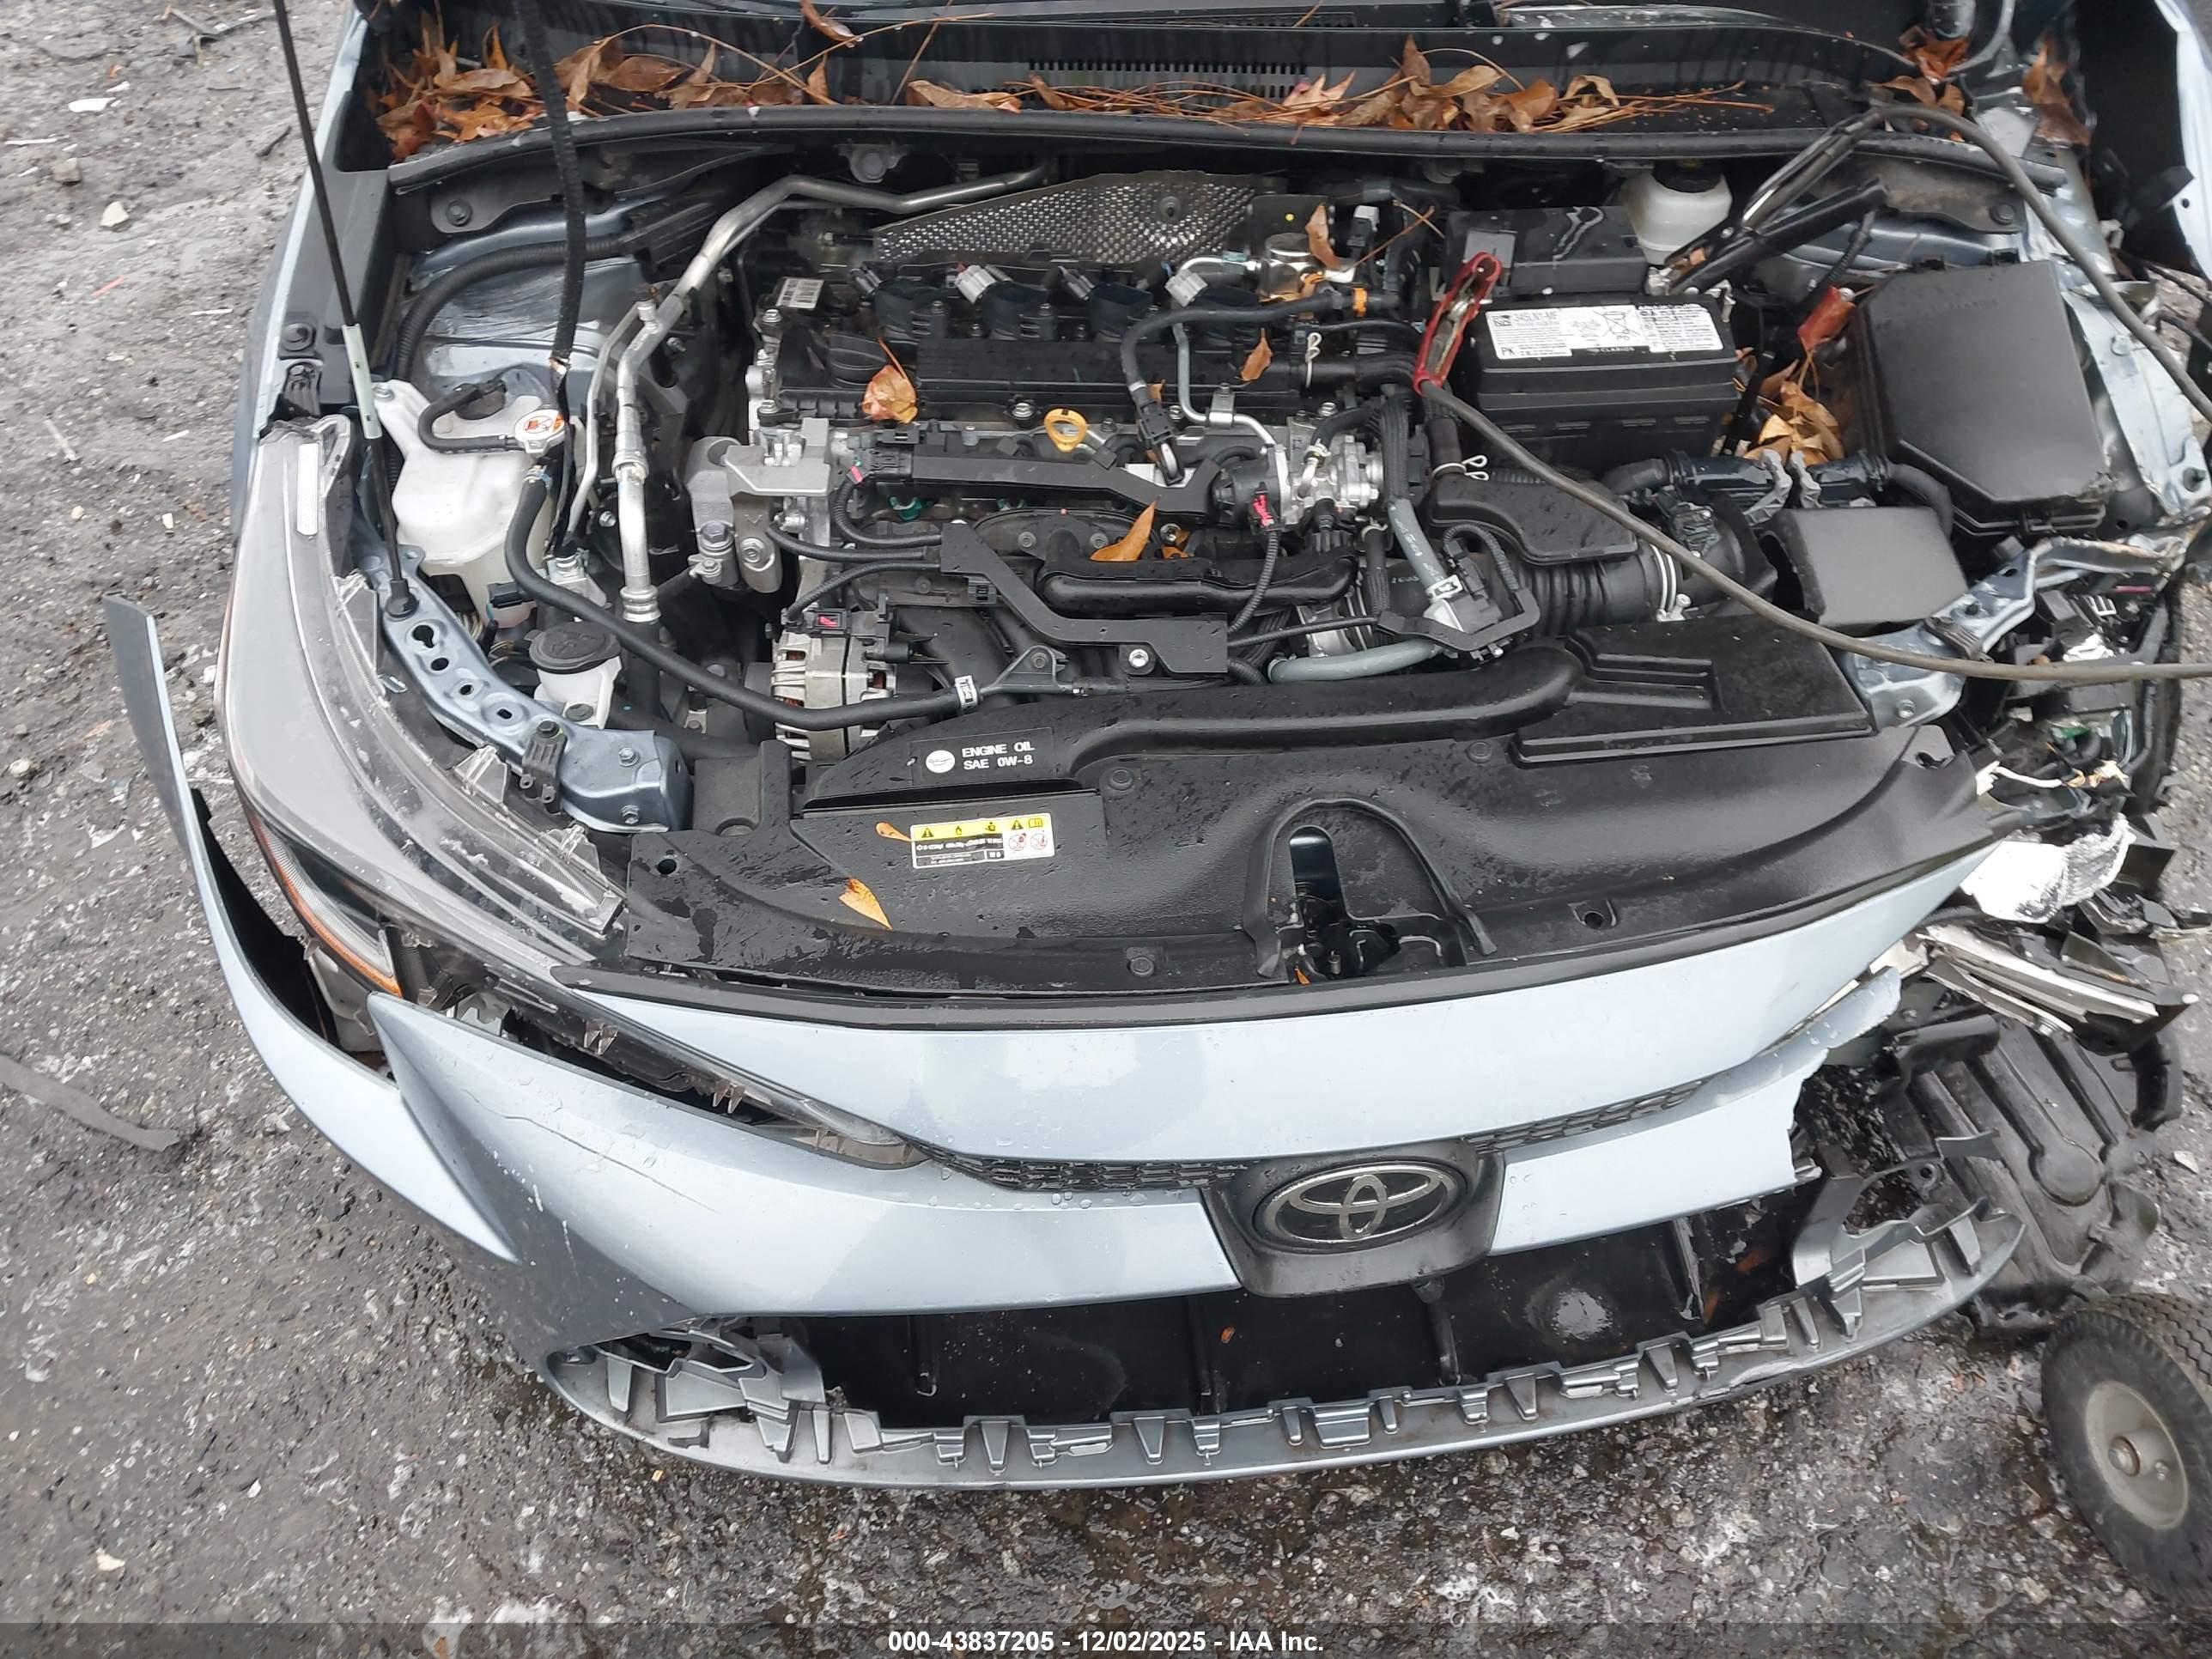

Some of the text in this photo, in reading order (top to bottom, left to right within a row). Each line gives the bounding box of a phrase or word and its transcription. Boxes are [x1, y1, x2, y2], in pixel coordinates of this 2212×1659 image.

[962, 741, 1036, 758] ENGINE OIL
[963, 755, 1033, 770] SAE 0W-8
